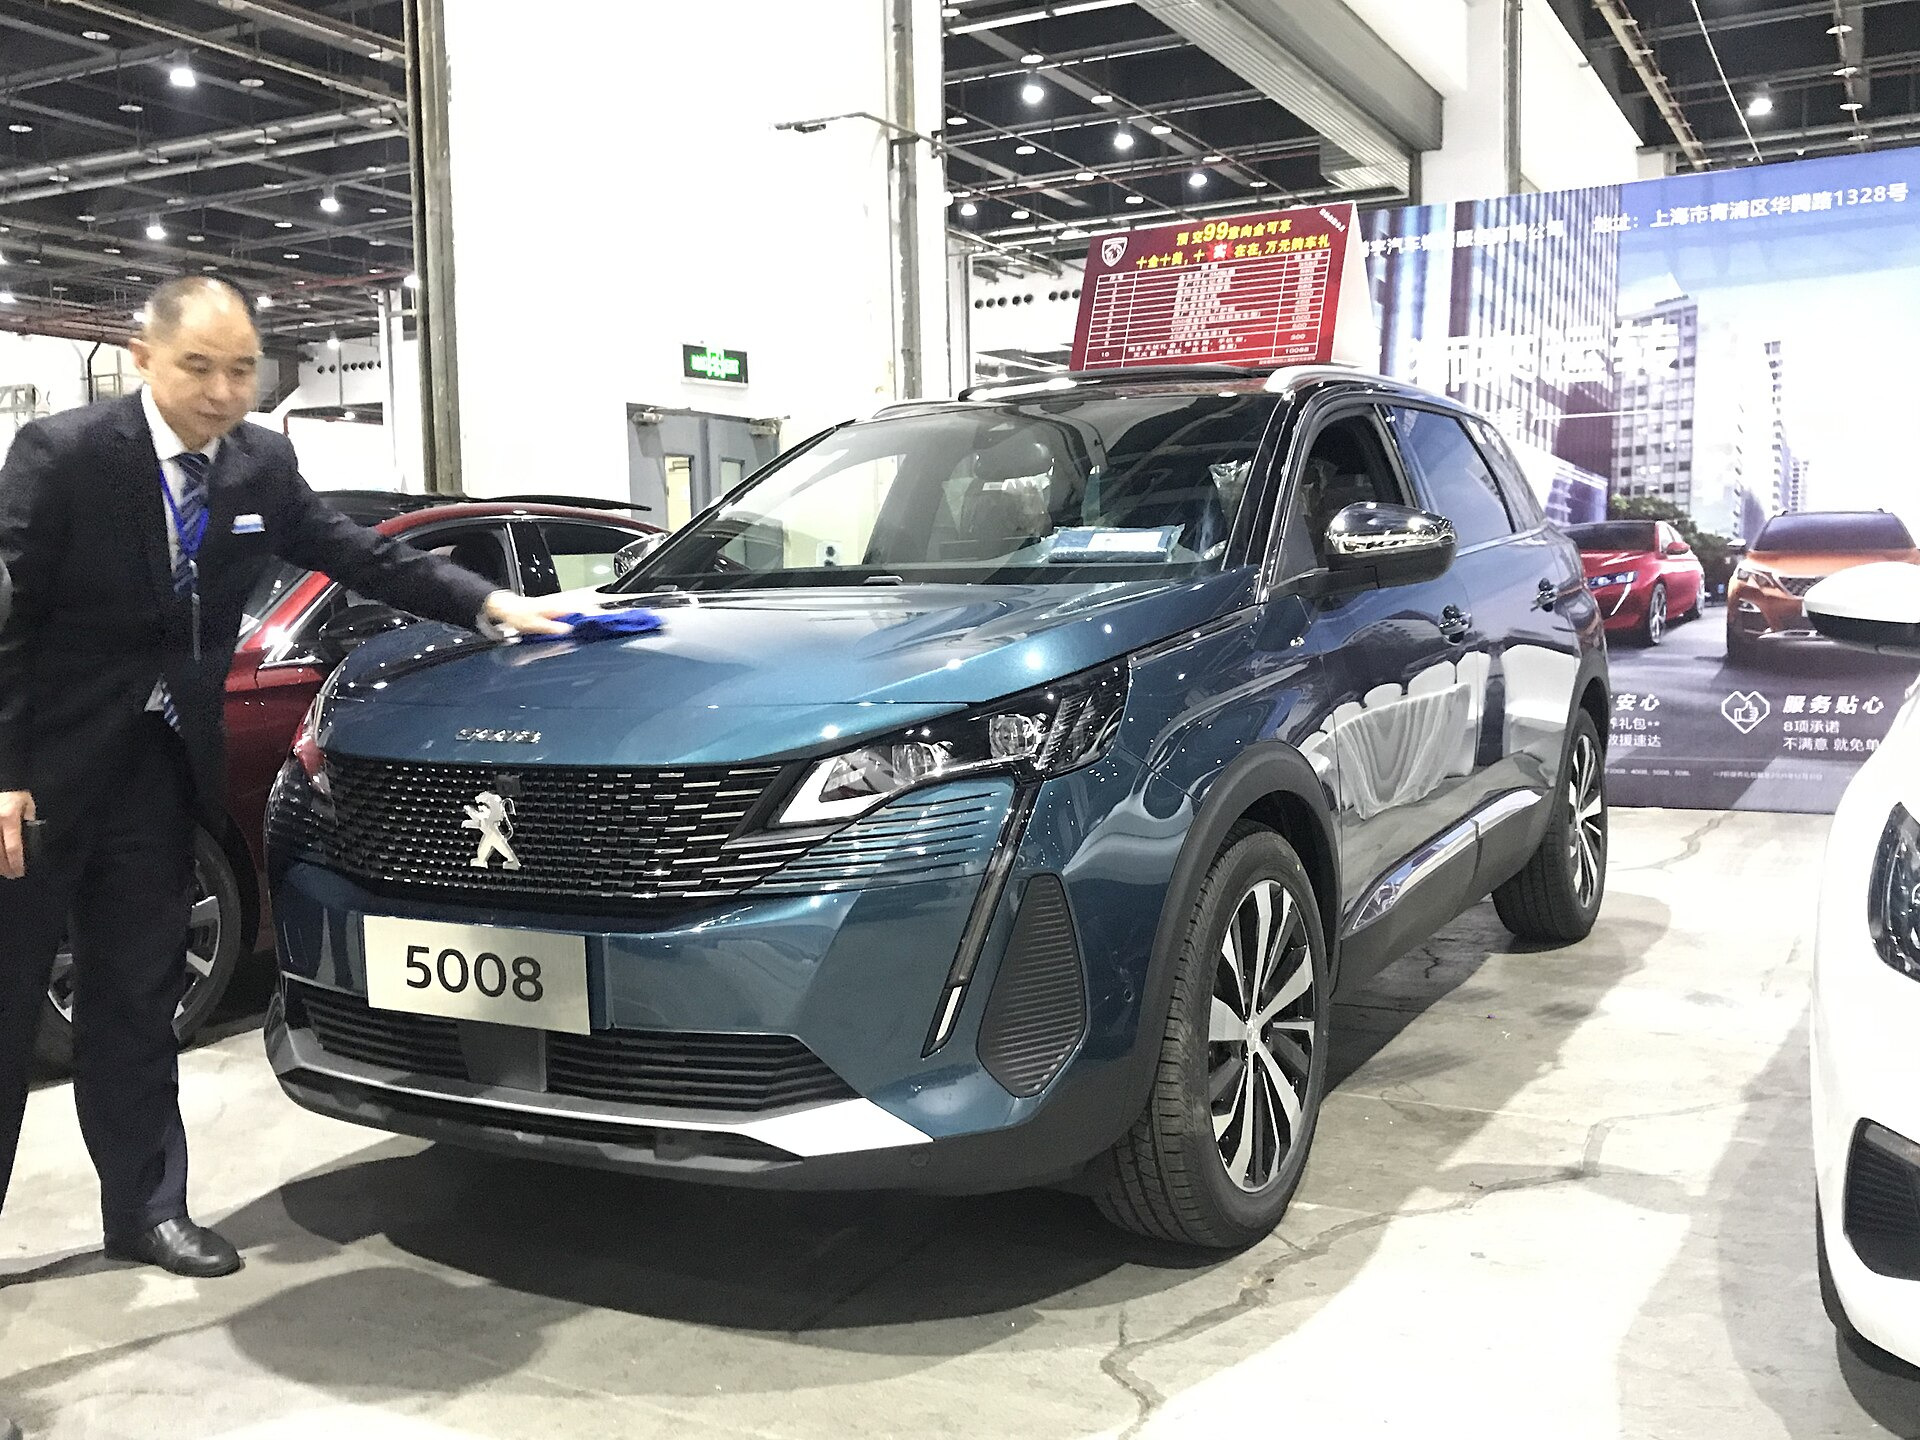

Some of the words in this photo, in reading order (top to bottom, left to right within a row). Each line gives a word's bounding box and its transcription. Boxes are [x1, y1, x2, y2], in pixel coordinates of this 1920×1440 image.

[1610, 693, 1660, 711] 安心
[1783, 695, 1885, 714] 服务贴心
[1783, 720, 1840, 734] 8项承诺
[1782, 737, 1828, 751] 不满意
[406, 945, 543, 1003] 5008
